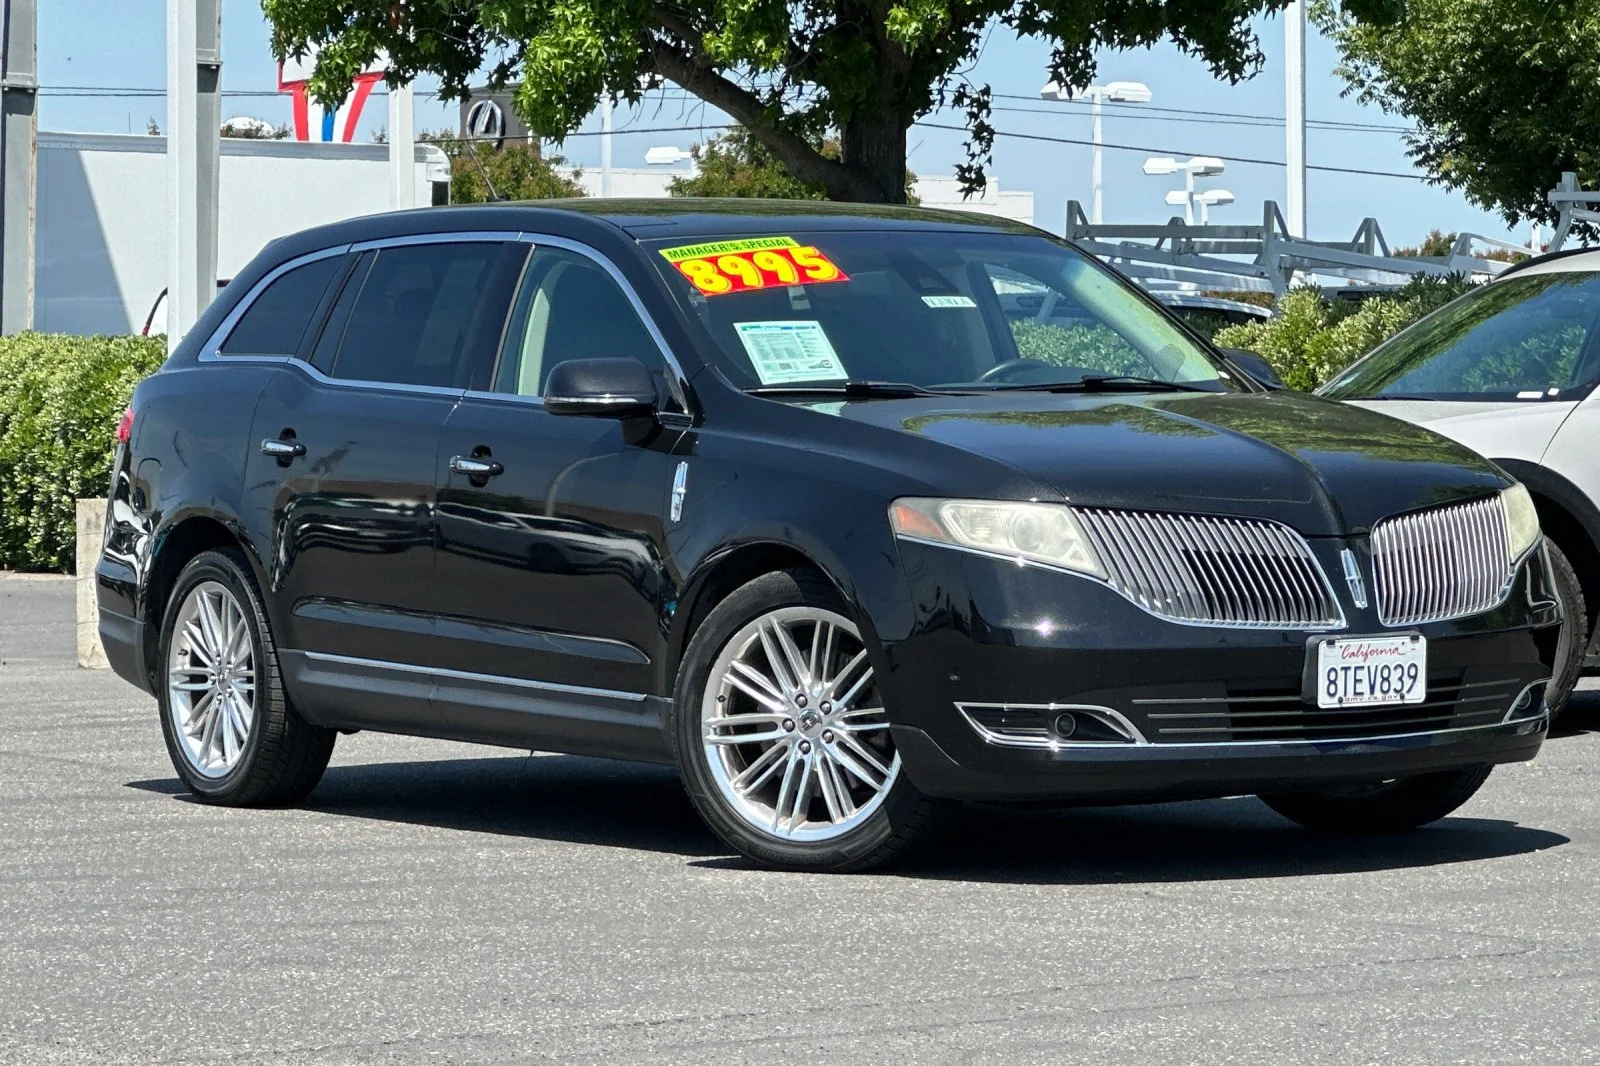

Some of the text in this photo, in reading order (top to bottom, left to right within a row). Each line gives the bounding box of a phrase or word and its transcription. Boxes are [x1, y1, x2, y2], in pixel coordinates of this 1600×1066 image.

[743, 238, 791, 249] SPECIAL
[679, 246, 839, 294] 8995
[1341, 643, 1406, 662] California
[1326, 662, 1419, 698] 8TEV839
